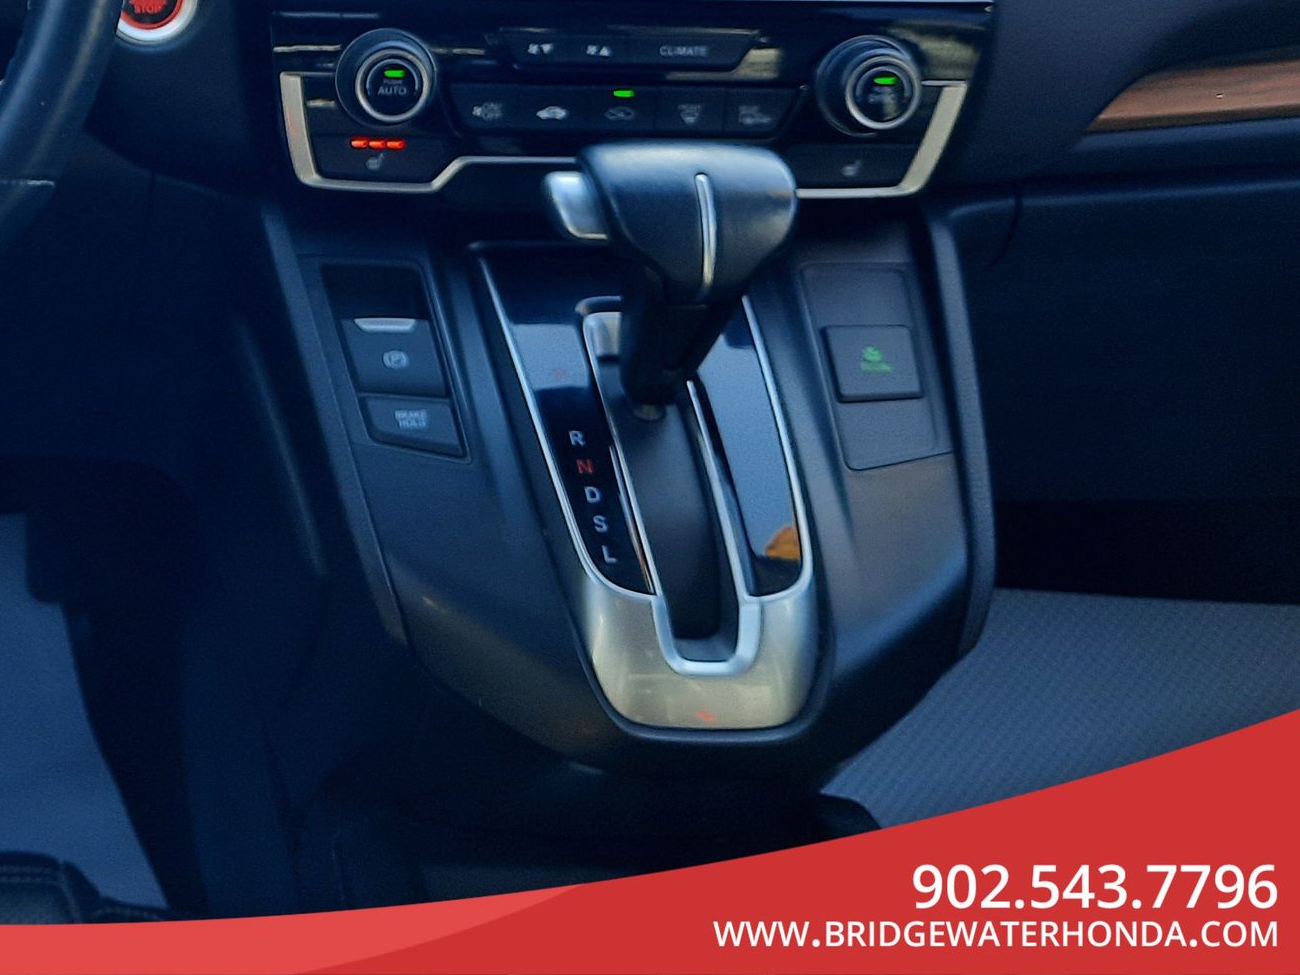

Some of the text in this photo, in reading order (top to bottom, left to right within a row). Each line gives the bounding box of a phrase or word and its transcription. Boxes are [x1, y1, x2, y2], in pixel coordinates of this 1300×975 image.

[660, 46, 708, 57] CLIMATE
[377, 86, 407, 96] AUTO
[569, 430, 586, 446] R
[576, 459, 594, 473] N
[585, 486, 601, 503] D
[593, 515, 608, 532] S
[602, 545, 617, 563] L
